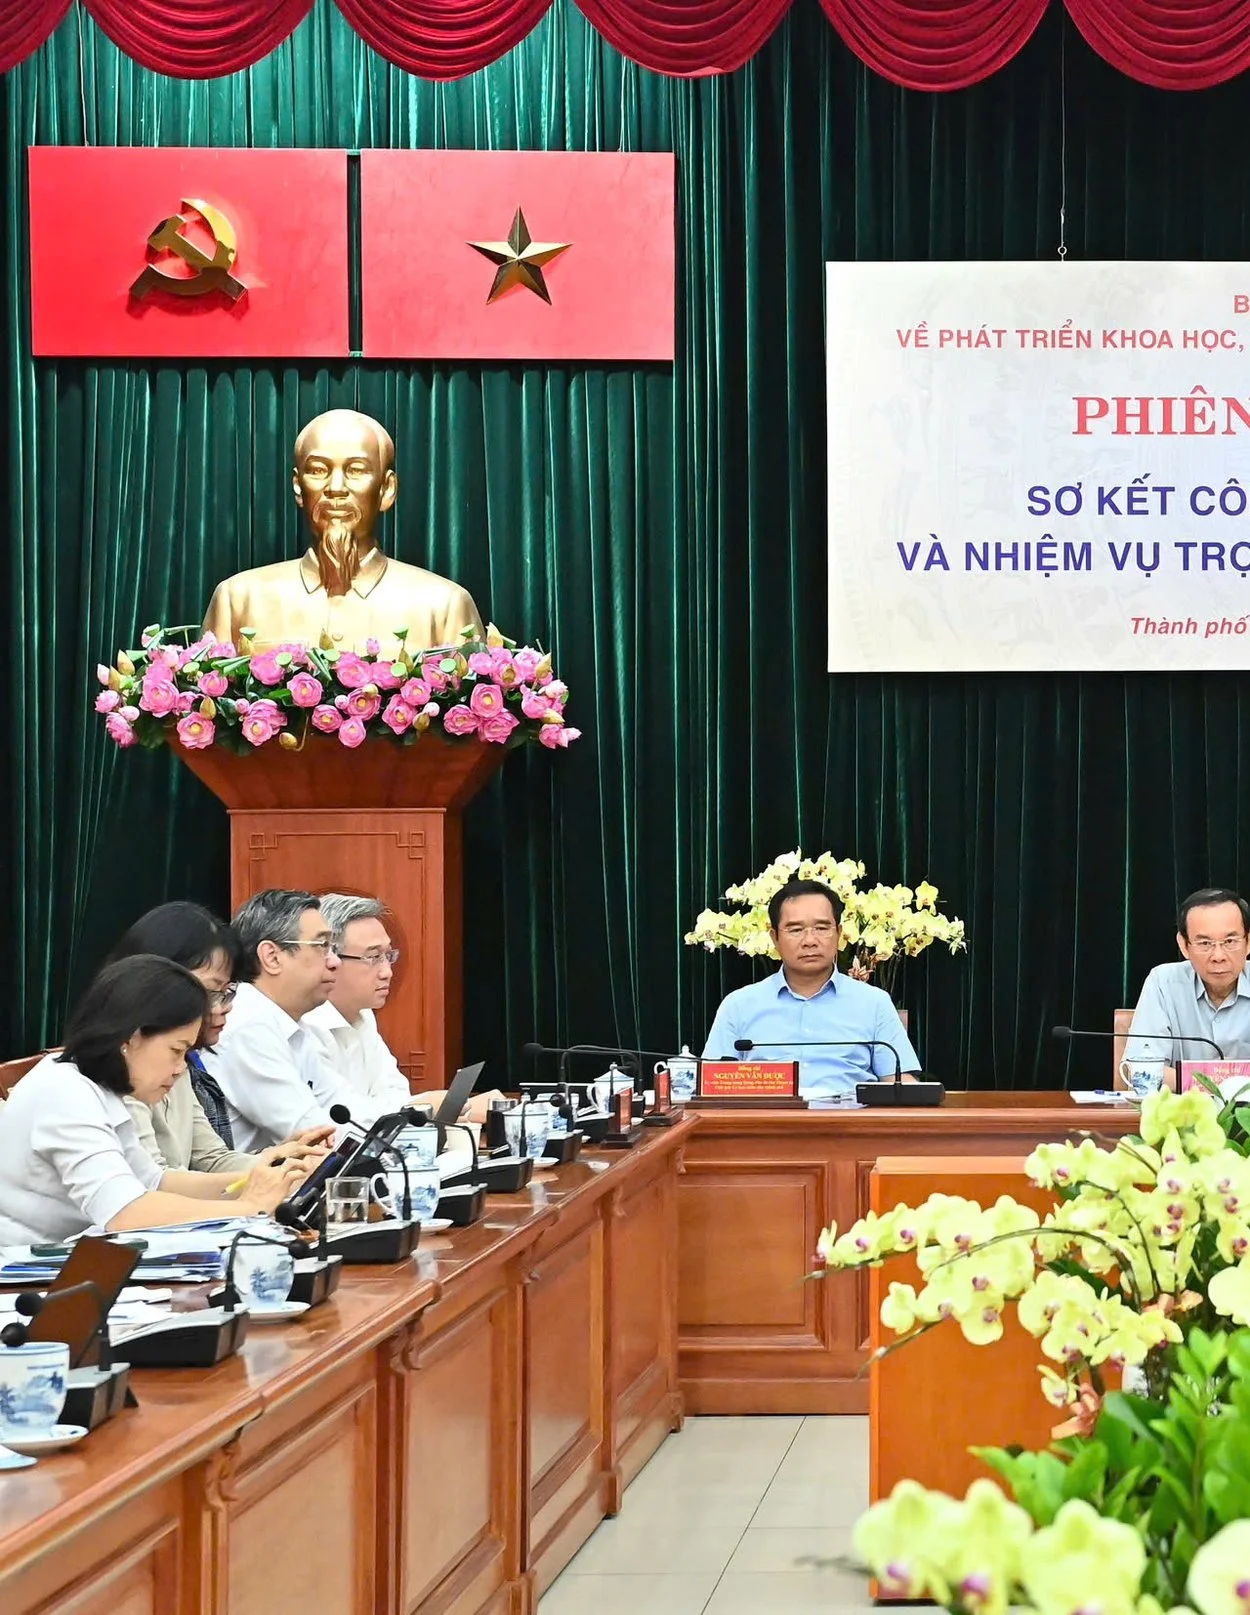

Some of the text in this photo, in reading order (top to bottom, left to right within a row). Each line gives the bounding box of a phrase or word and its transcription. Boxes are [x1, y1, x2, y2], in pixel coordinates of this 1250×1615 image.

[896, 321, 931, 350] VỀ
[939, 324, 1009, 350] PHÁT
[1016, 319, 1093, 350] TRIỂN
[1103, 330, 1175, 351] KHOA
[1183, 330, 1245, 355] HỌC,
[1028, 482, 1084, 518] SƠ
[1098, 473, 1177, 517] KẾT
[897, 534, 952, 573] VÀ
[965, 534, 1093, 580] NHIỆM
[1108, 542, 1162, 579] VỤ
[1131, 617, 1200, 636] Thành
[1205, 615, 1250, 640] phố
